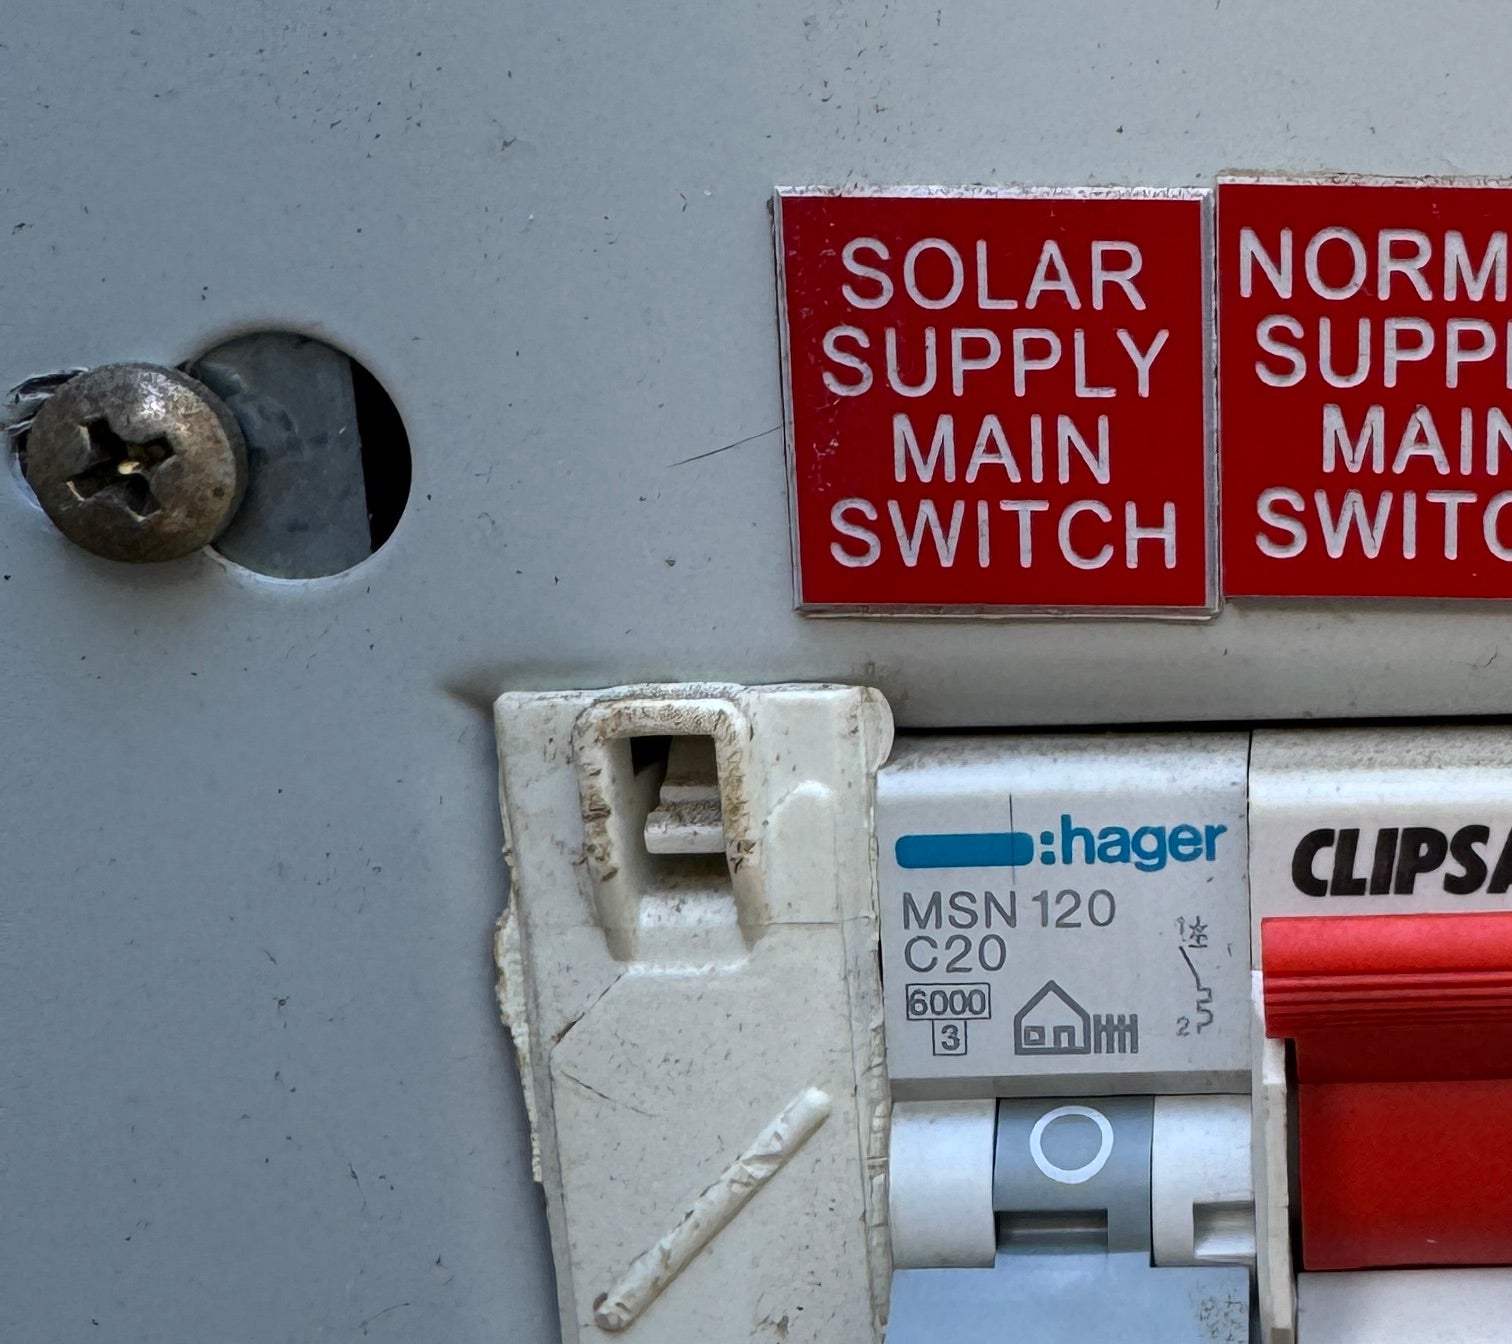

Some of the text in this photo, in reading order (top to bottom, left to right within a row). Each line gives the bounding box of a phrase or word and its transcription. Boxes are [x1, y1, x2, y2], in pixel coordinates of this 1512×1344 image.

[840, 237, 1147, 311] SOLAR
[821, 324, 1170, 399] SUPPLY
[892, 413, 1110, 485] MAIN
[830, 498, 1177, 570] SWITCH
[904, 934, 1007, 973] C20
[908, 988, 987, 1017] 6000
[940, 1023, 962, 1052] 3
